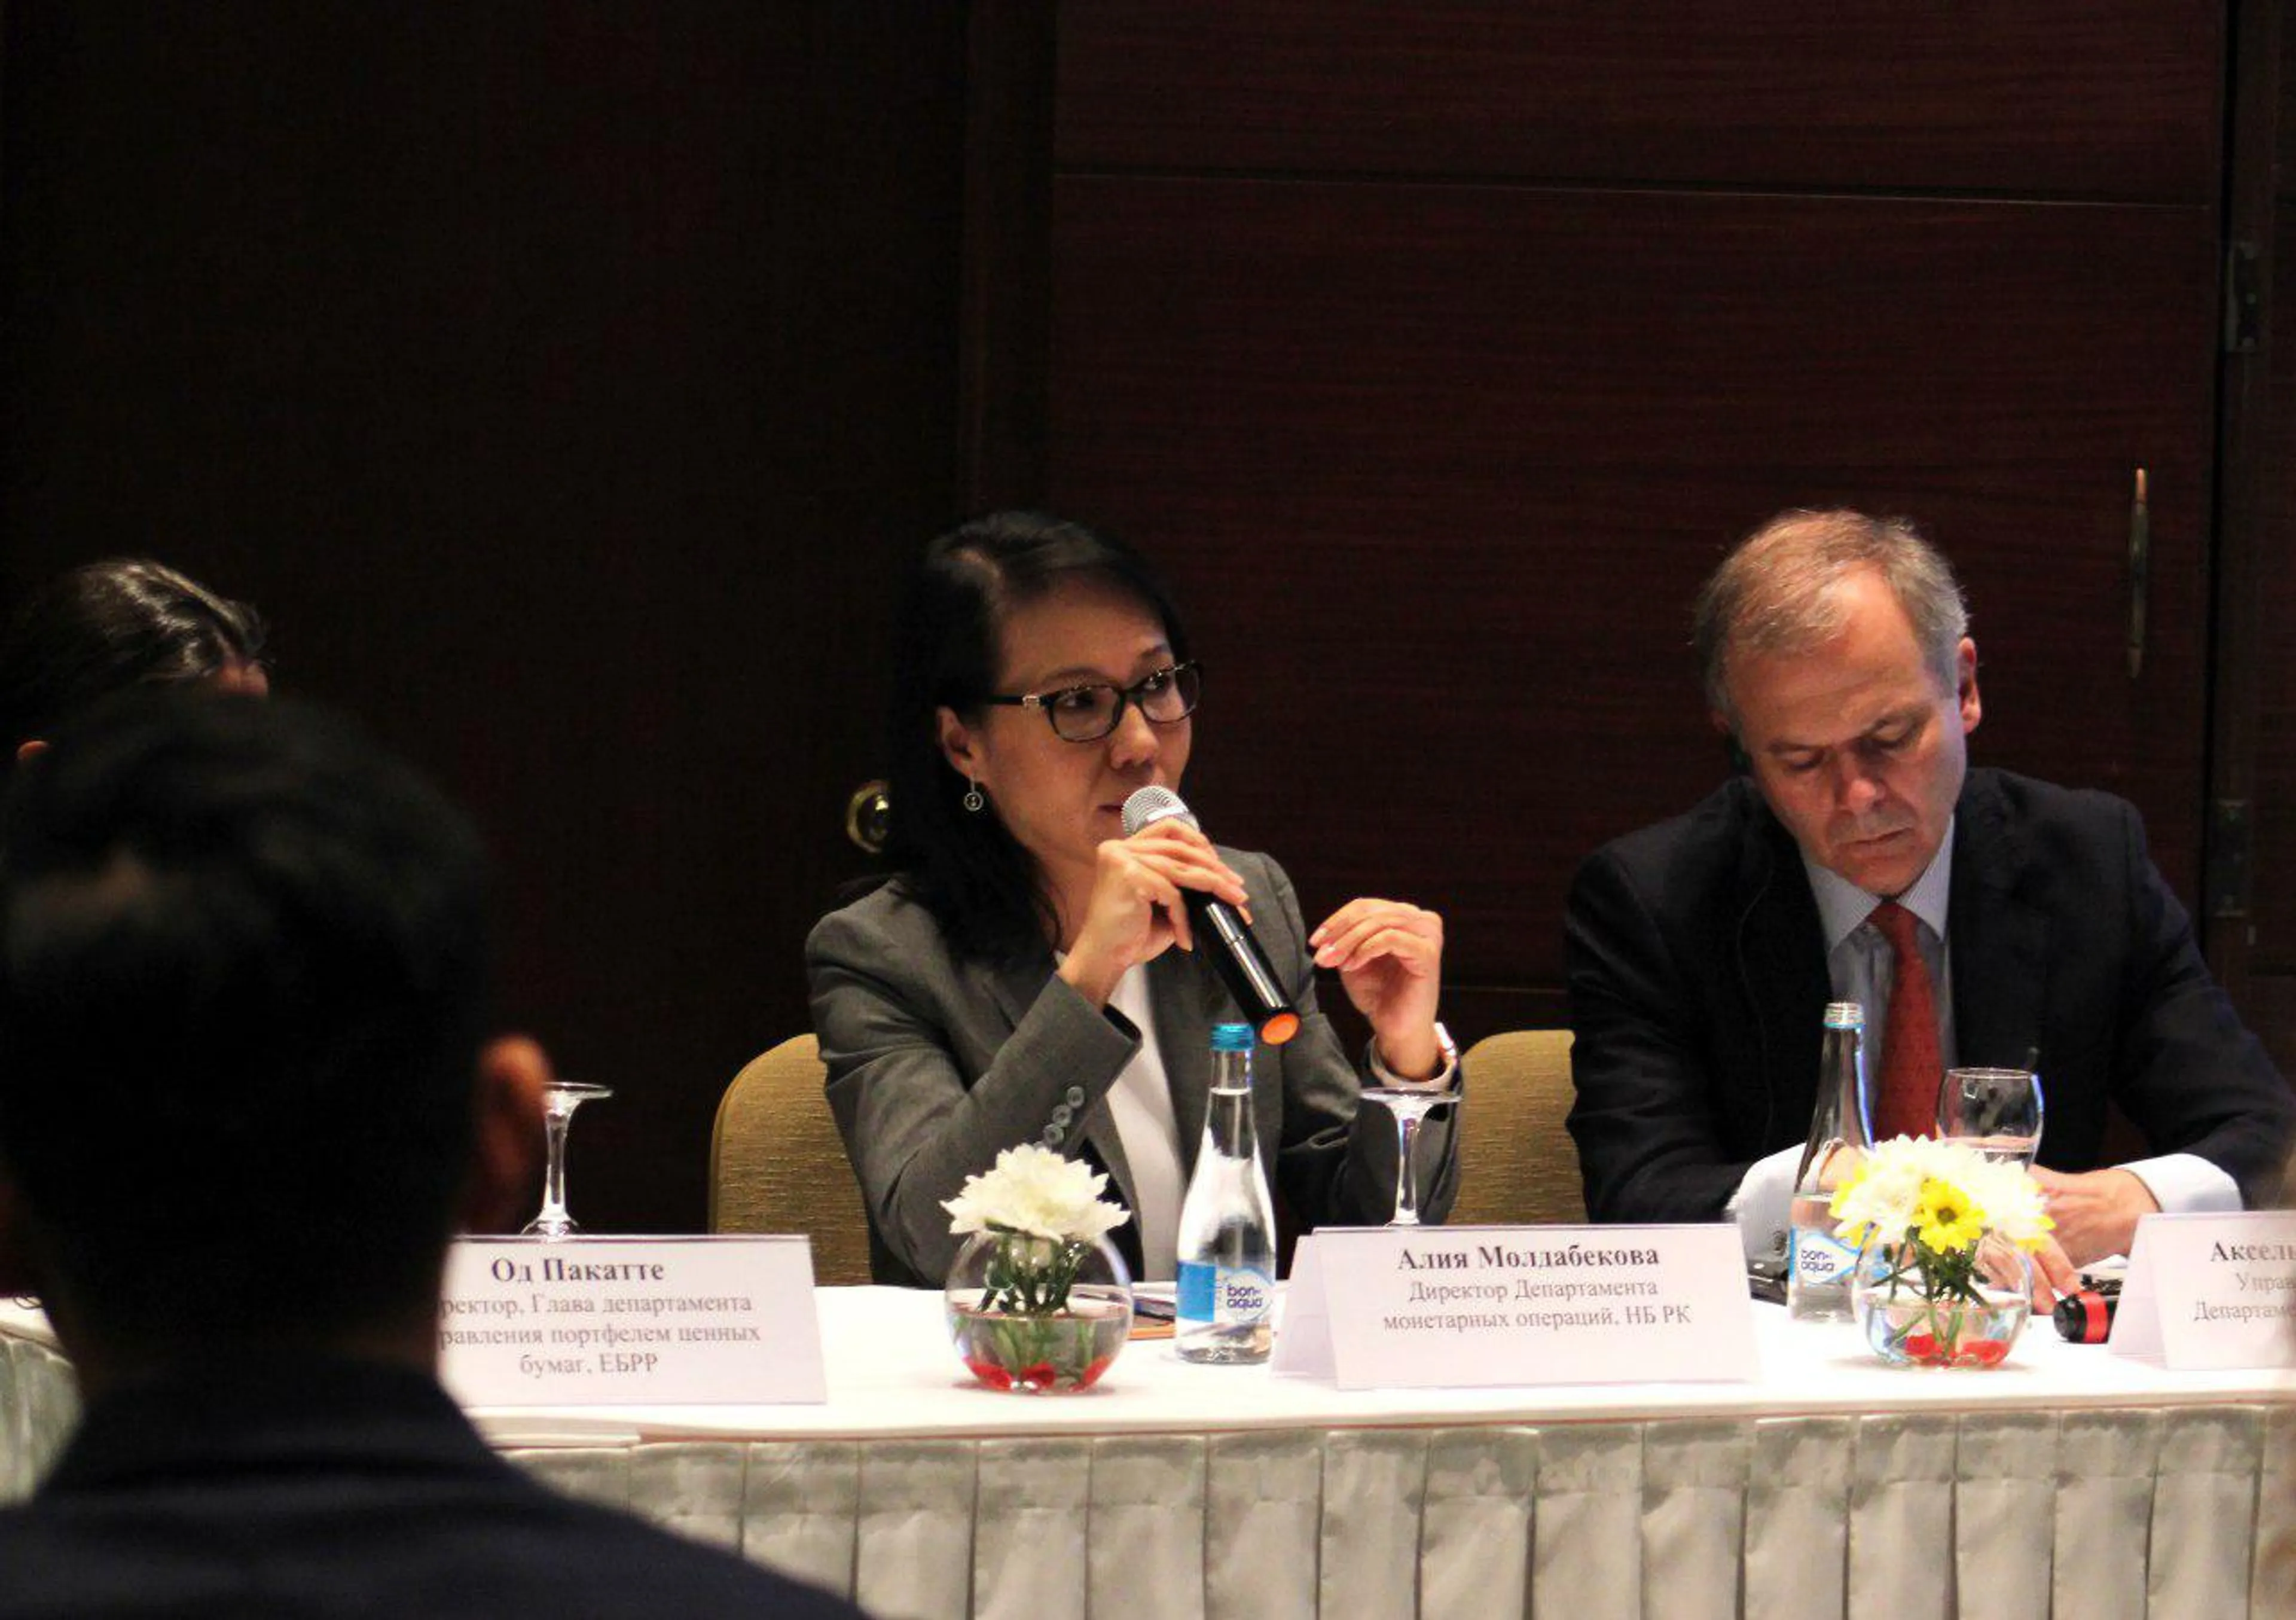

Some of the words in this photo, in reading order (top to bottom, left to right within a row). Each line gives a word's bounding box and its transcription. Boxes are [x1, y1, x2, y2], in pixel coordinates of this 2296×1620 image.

[1398, 1247, 1468, 1270] Алия
[1478, 1244, 1660, 1269] Молдабекова
[490, 1257, 532, 1284] Од
[543, 1258, 665, 1282] Пакатте
[1227, 1298, 1263, 1311] aqua
[1409, 1281, 1509, 1305] Директор
[1515, 1279, 1659, 1303] Департамента
[441, 1296, 525, 1319] ректор,
[531, 1293, 595, 1314] Глава
[602, 1294, 752, 1317] департамента
[1384, 1311, 1510, 1333] монетарных
[1516, 1307, 1620, 1331] операций,
[1626, 1305, 1657, 1325] НБ
[1663, 1305, 1692, 1325] РК
[439, 1329, 544, 1350] равления
[551, 1320, 670, 1348] портфелем
[678, 1325, 761, 1346] ценных
[519, 1353, 593, 1379] бумаг,
[599, 1351, 659, 1374] ЕБРР
